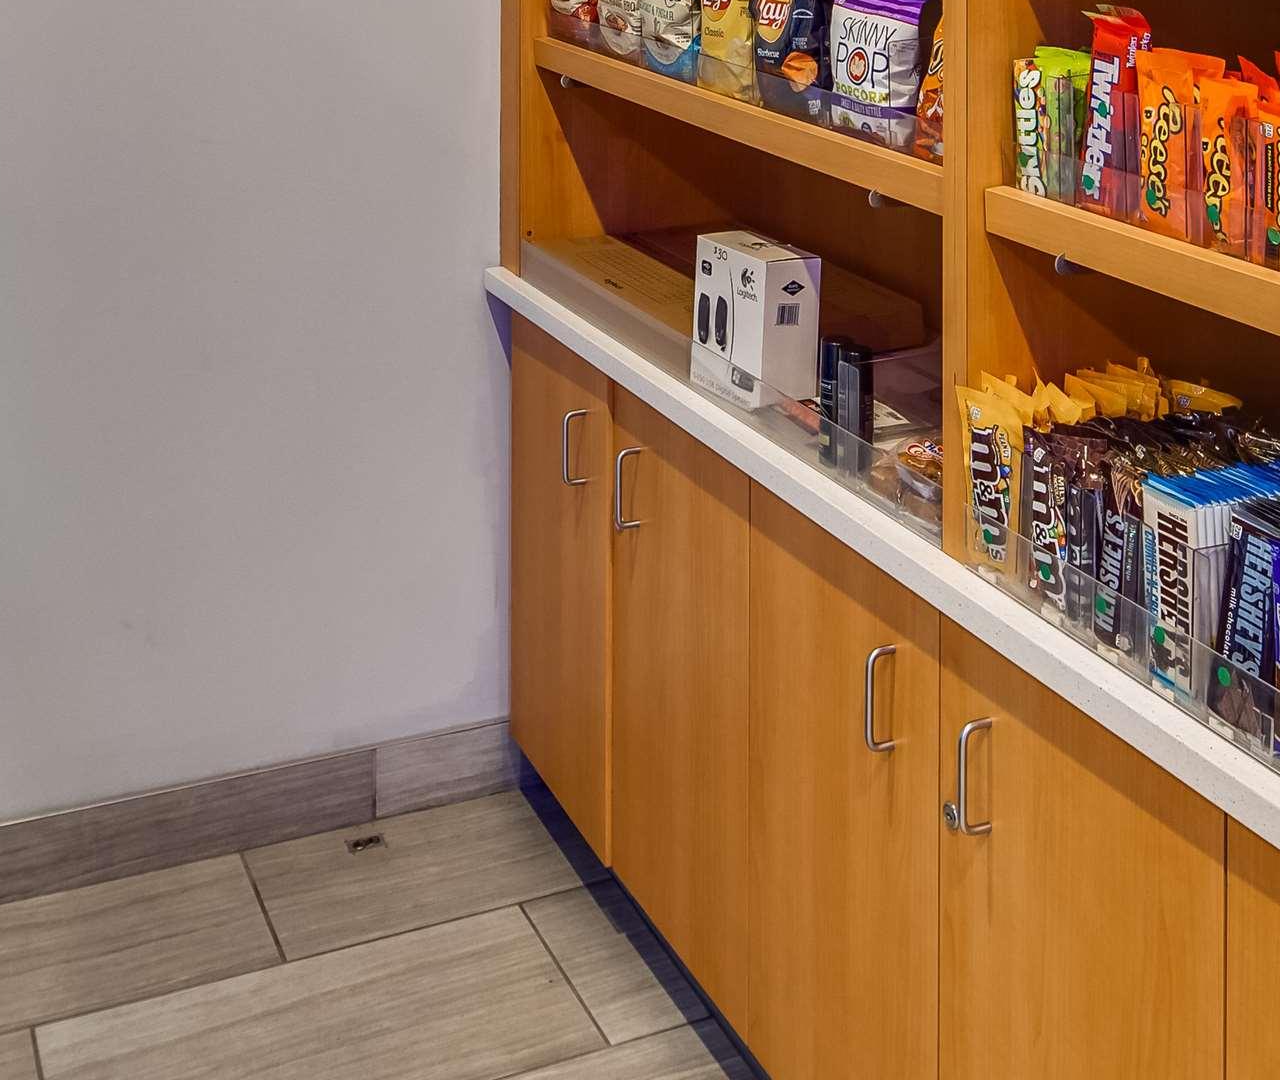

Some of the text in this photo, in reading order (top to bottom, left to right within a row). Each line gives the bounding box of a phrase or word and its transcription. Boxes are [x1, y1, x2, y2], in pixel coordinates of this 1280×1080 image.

[704, 26, 725, 38] Classic
[840, 16, 898, 51] SKINNY
[757, 47, 780, 59] Barbecue
[834, 41, 890, 89] POP
[835, 81, 891, 105] POPCORN
[1146, 85, 1183, 218] Reese's
[736, 288, 758, 303] Logitech
[997, 430, 1011, 459] PEANUT
[1222, 587, 1237, 658] milk chocolate
[1227, 533, 1274, 681] HERSHEY'S
